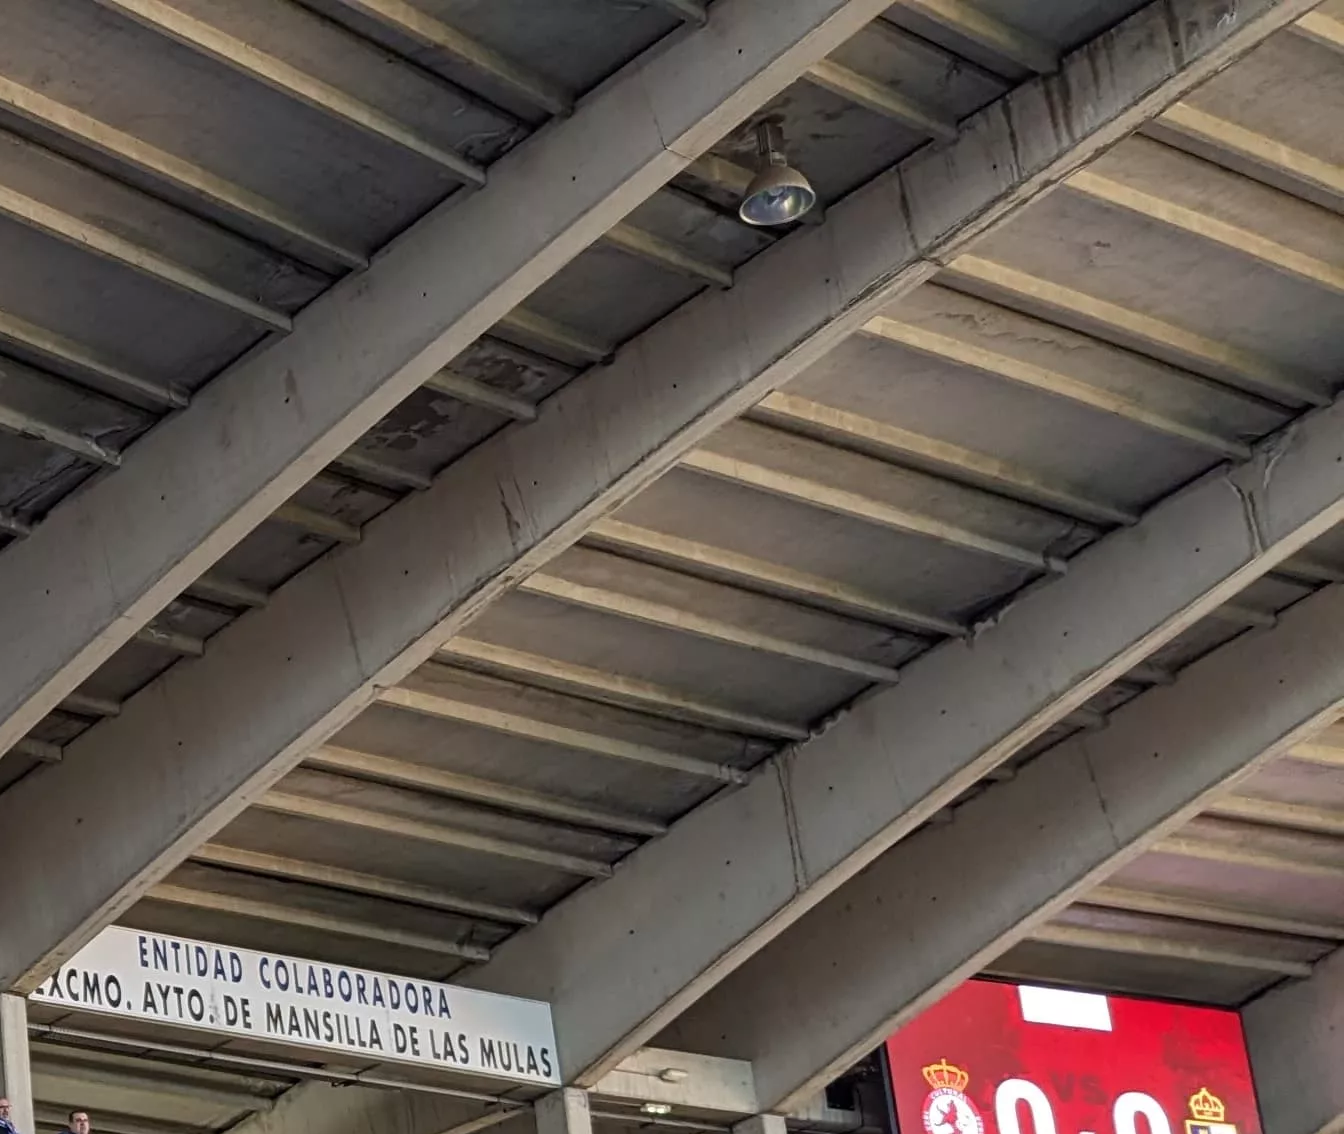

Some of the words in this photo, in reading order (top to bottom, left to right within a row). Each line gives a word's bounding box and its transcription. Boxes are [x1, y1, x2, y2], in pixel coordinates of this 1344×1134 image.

[138, 936, 243, 984] ENTIDAD
[259, 956, 451, 1019] COLABORADORA
[142, 982, 214, 1024] AYTO.
[224, 994, 253, 1031] DE
[266, 1003, 385, 1052] MANSILLA
[392, 1022, 421, 1057] DE
[430, 1031, 469, 1065] LAS
[480, 1038, 553, 1078] MULAS
